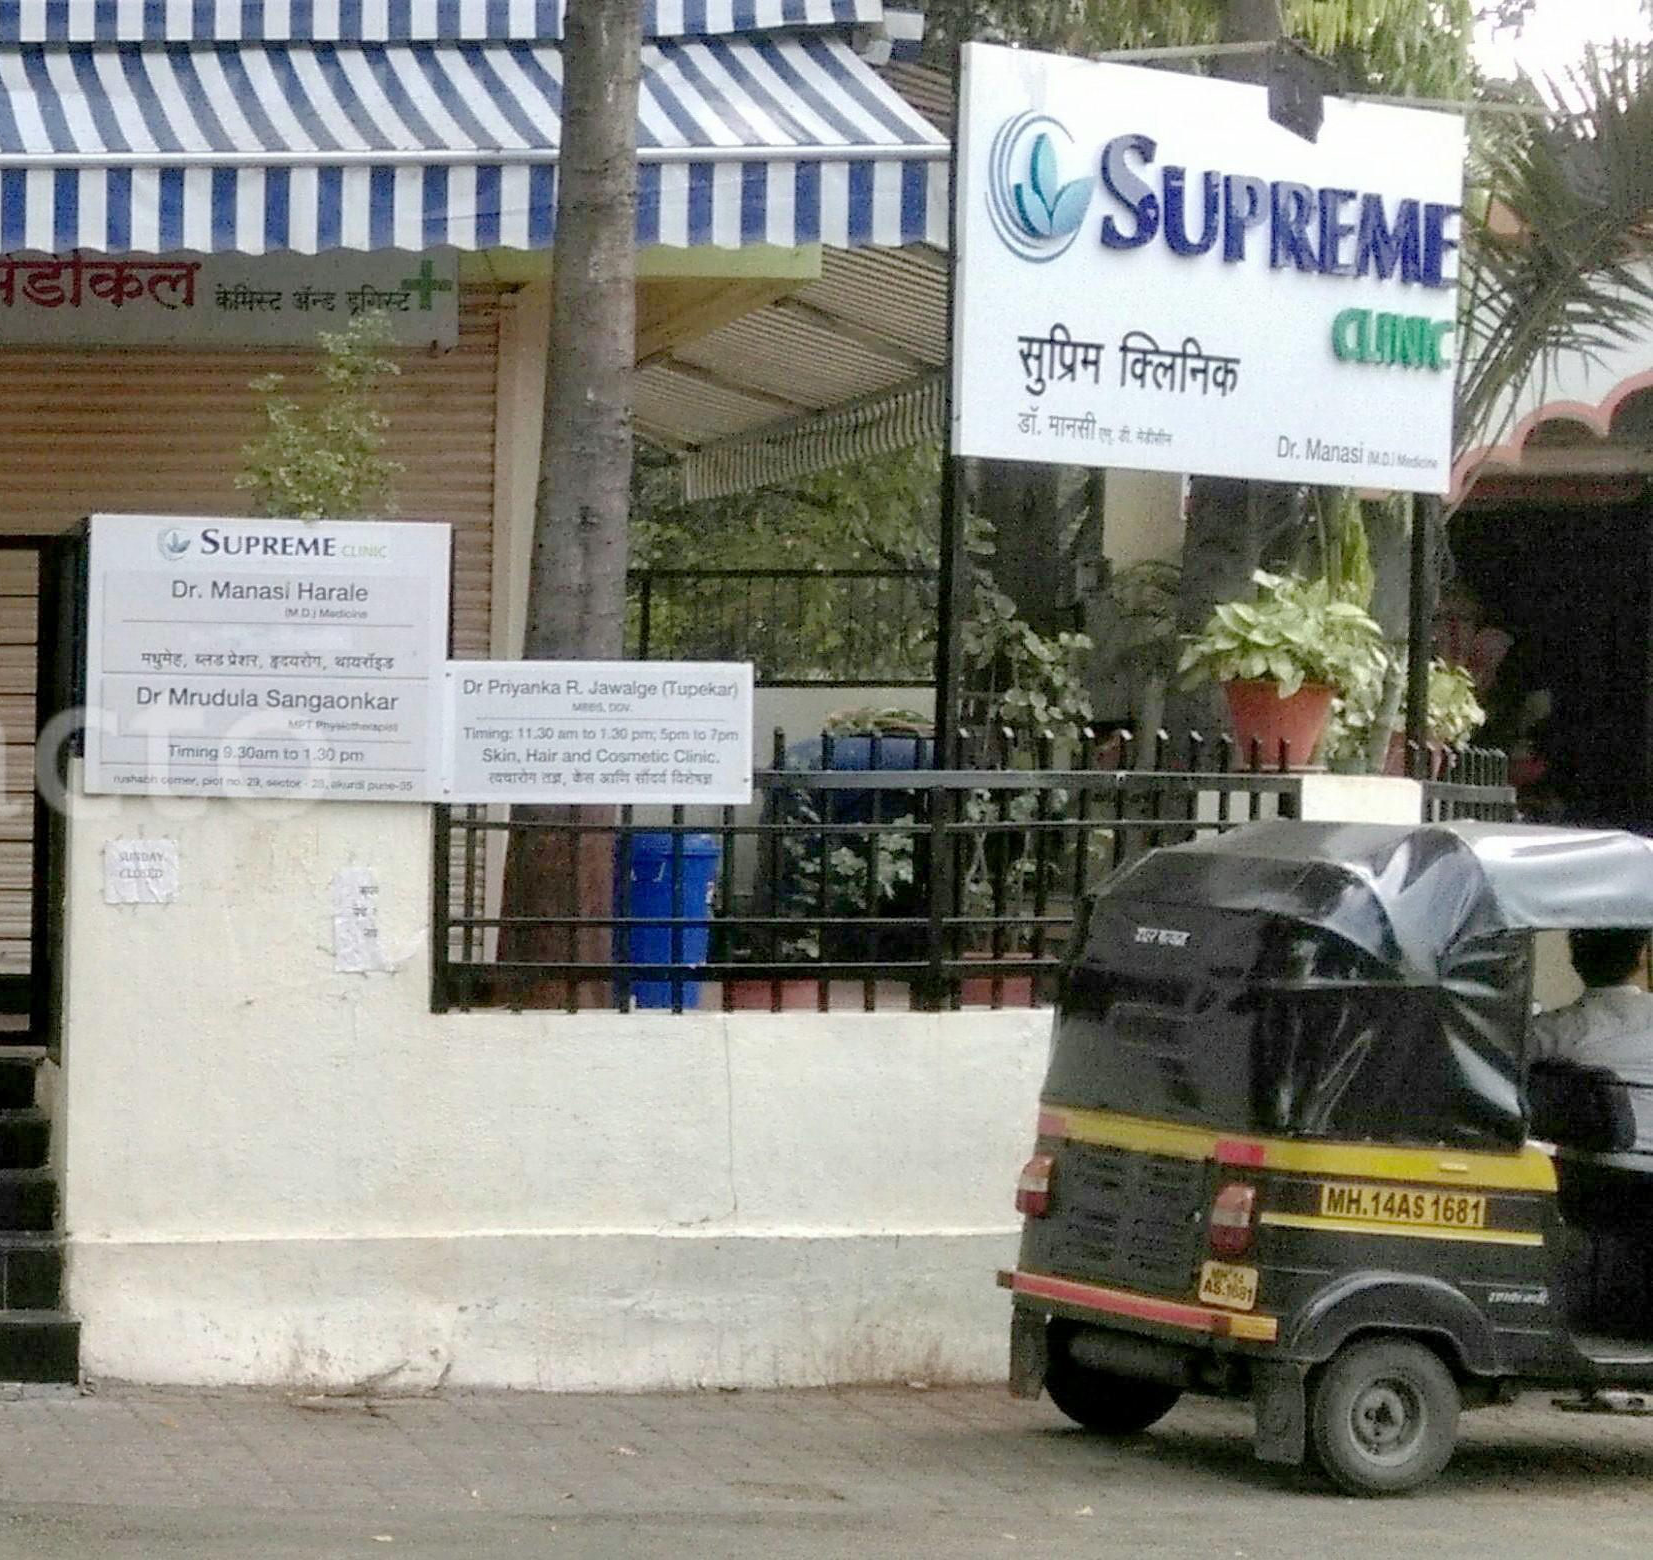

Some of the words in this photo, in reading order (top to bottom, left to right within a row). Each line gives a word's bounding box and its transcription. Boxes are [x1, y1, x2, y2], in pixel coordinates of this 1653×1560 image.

[1331, 307, 1456, 372] CLINIC
[1017, 322, 1105, 396] सुप्रिम
[1118, 330, 1241, 397] क्लिनिक
[1018, 405, 1042, 436] डॉ.
[1047, 410, 1097, 441] मानसी
[1277, 435, 1301, 460] Dr.
[1305, 437, 1364, 464] Manasi
[199, 528, 337, 558] SUPREME
[340, 543, 388, 560] CLINIC
[171, 579, 203, 600] Dr.
[210, 580, 291, 601] Manasi
[296, 581, 370, 603] Harale
[319, 608, 369, 620] Medicine
[141, 650, 187, 671] मधुमेह,
[136, 686, 161, 706] Dr
[168, 687, 259, 708] Mrudula
[265, 689, 400, 714] Sangaonkar
[462, 679, 483, 695] Dr
[487, 679, 561, 698] Priyanka
[565, 680, 583, 696] R.
[588, 680, 657, 699] Jawalge
[662, 680, 738, 699] (Tupekar)
[315, 719, 399, 734] Physiotherapist
[463, 727, 513, 744] Timing:
[517, 727, 553, 741] 11.30
[557, 729, 579, 741] am
[582, 729, 597, 741] to
[600, 728, 628, 741] 1.30
[660, 729, 689, 744] 5pm
[693, 729, 707, 742] to
[710, 729, 739, 744] 7pm
[168, 743, 219, 763] Timing
[222, 745, 280, 762] 9.30am
[283, 747, 298, 762] to
[303, 747, 336, 762] 1.30
[339, 750, 365, 766] pm
[481, 749, 522, 765] Skin,
[526, 749, 557, 763] Hair
[561, 749, 591, 763] and
[596, 749, 669, 764] Cosmetic
[673, 750, 721, 764] Clinic.
[572, 770, 595, 784] केस
[598, 770, 630, 785] आणि
[118, 867, 164, 880] CLOSED
[1429, 1194, 1482, 1225] 1681
